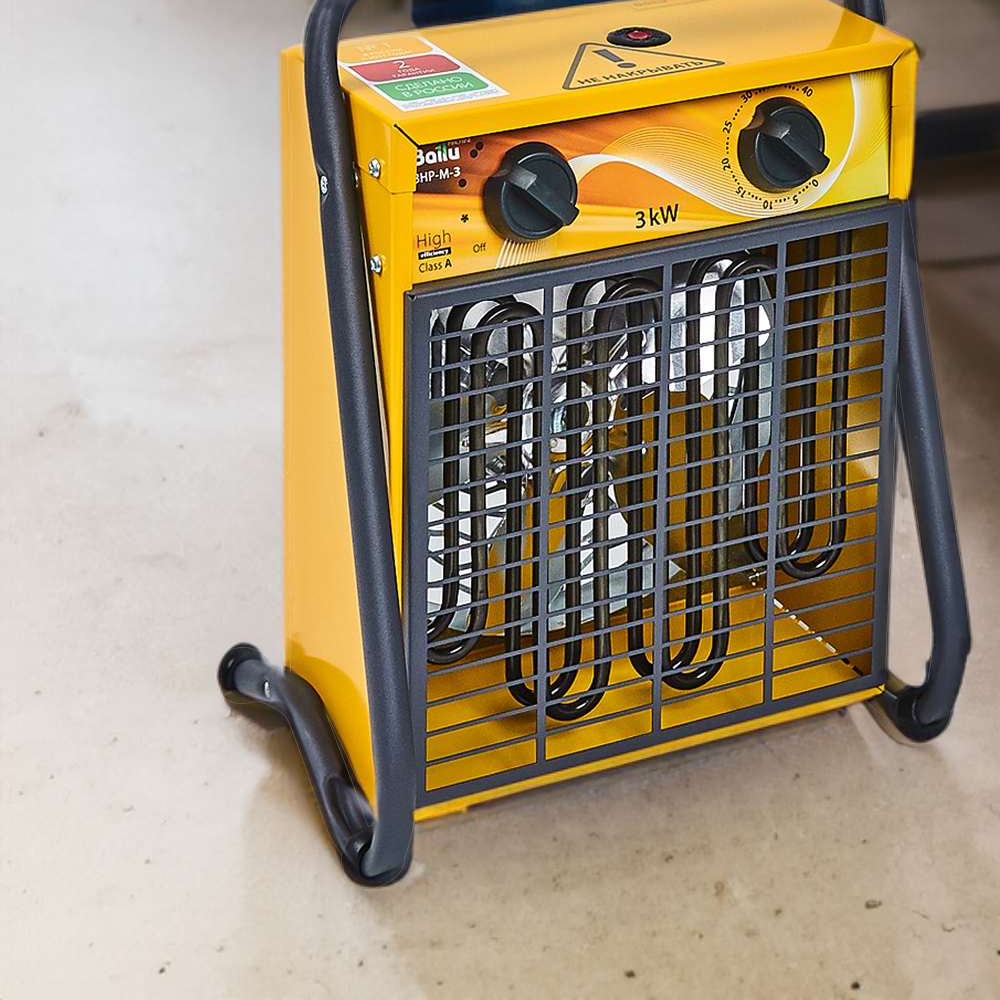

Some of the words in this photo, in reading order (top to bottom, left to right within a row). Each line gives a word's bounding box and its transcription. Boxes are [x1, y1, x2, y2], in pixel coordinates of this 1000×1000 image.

[393, 60, 410, 69] 2
[392, 68, 436, 78] ГАРАНТИИ
[577, 76, 599, 85] НЕ
[602, 60, 704, 81] НАКРЫВАТЬ
[395, 76, 463, 91] СДЕЛАНО
[415, 81, 474, 96] РОССИИ
[740, 91, 753, 103] 30
[801, 85, 813, 97] 40
[722, 120, 733, 134] 25
[721, 157, 731, 171] 20
[811, 179, 819, 188] 0
[735, 186, 747, 198] 15
[763, 200, 773, 210] 10
[792, 195, 799, 204] 5
[416, 229, 451, 249] High
[420, 248, 449, 258] efficiency
[472, 242, 487, 253] Off
[418, 261, 443, 273] Class
[445, 258, 453, 268] A
